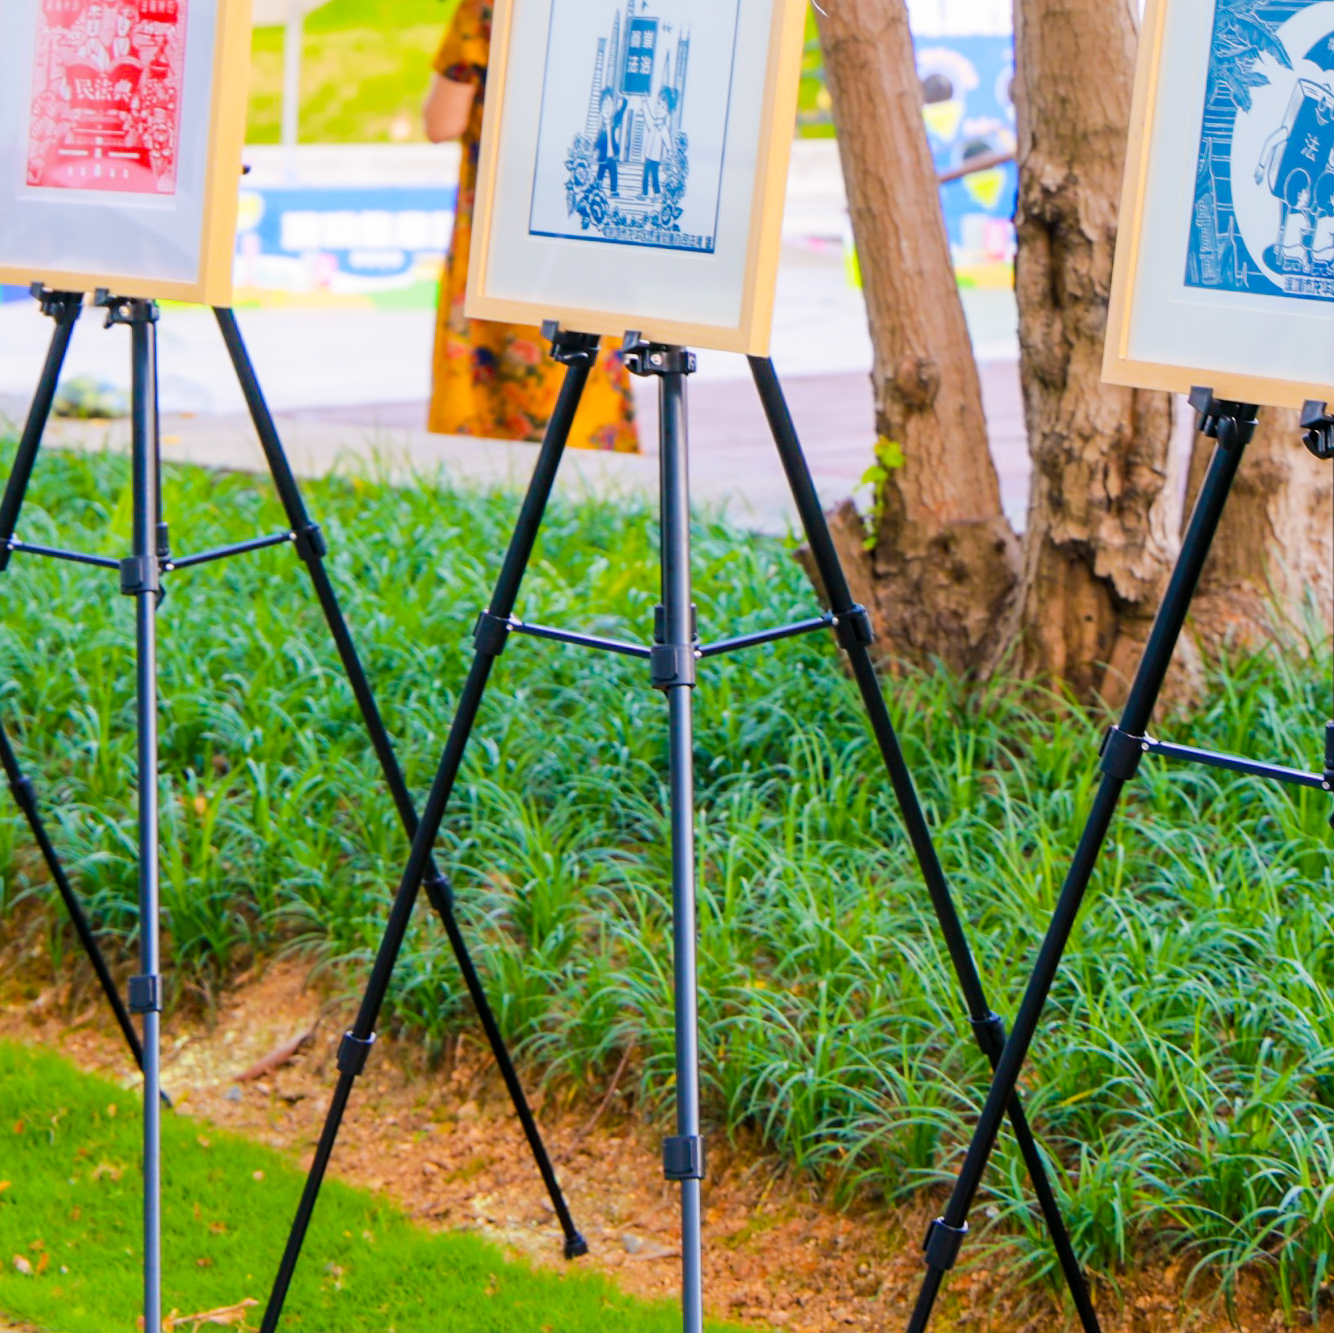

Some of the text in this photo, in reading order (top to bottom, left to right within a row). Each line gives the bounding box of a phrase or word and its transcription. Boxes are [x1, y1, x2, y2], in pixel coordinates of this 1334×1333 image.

[74, 78, 132, 101] 民法典
[1300, 132, 1321, 163] 法
